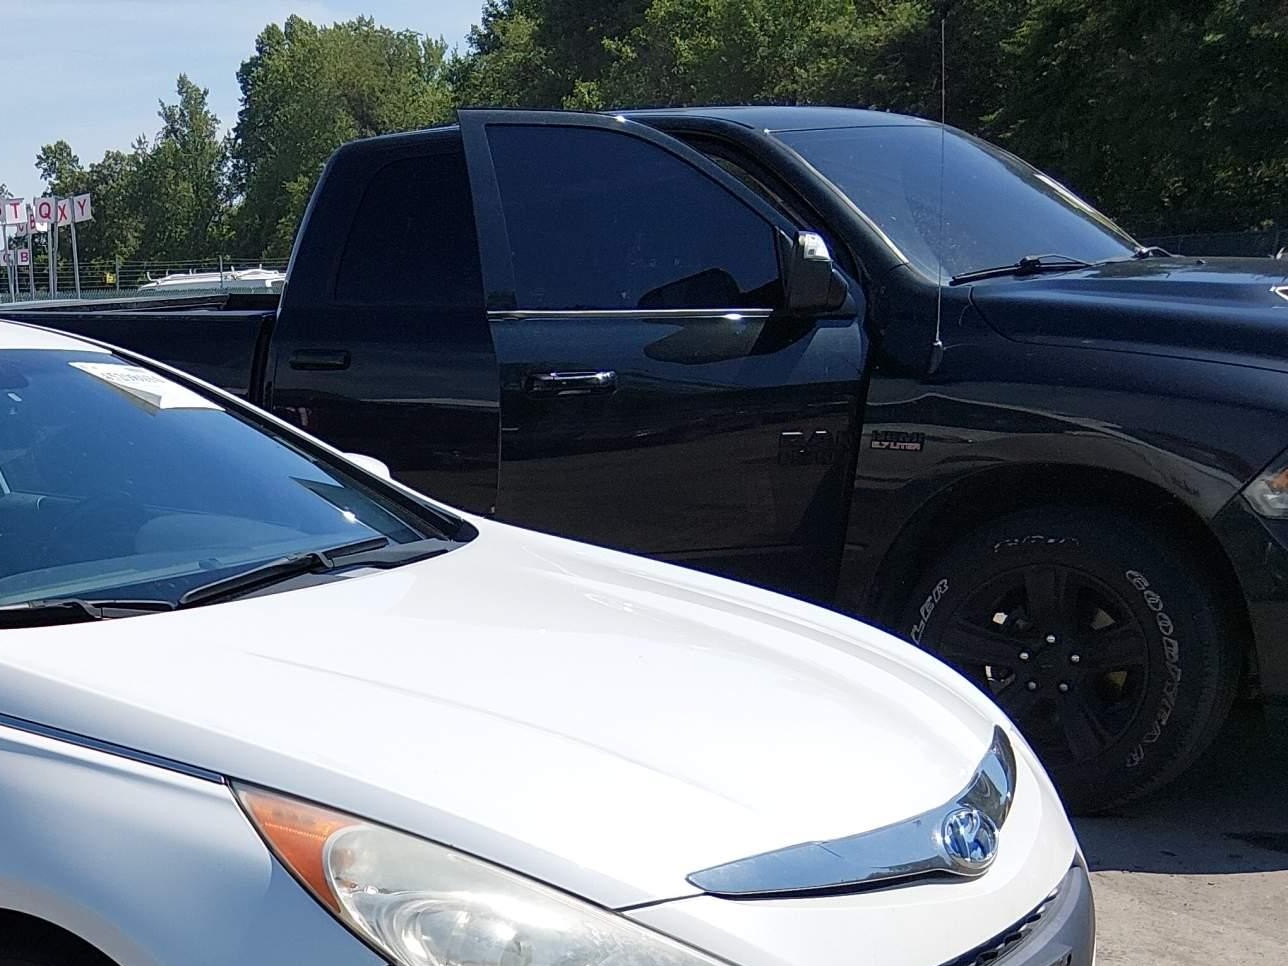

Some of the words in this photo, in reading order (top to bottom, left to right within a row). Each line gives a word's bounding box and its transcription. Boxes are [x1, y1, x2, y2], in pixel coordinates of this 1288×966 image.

[9, 202, 20, 219] T
[39, 202, 51, 220] Q
[58, 203, 68, 221] X
[78, 199, 87, 217] Y
[21, 252, 29, 263] B
